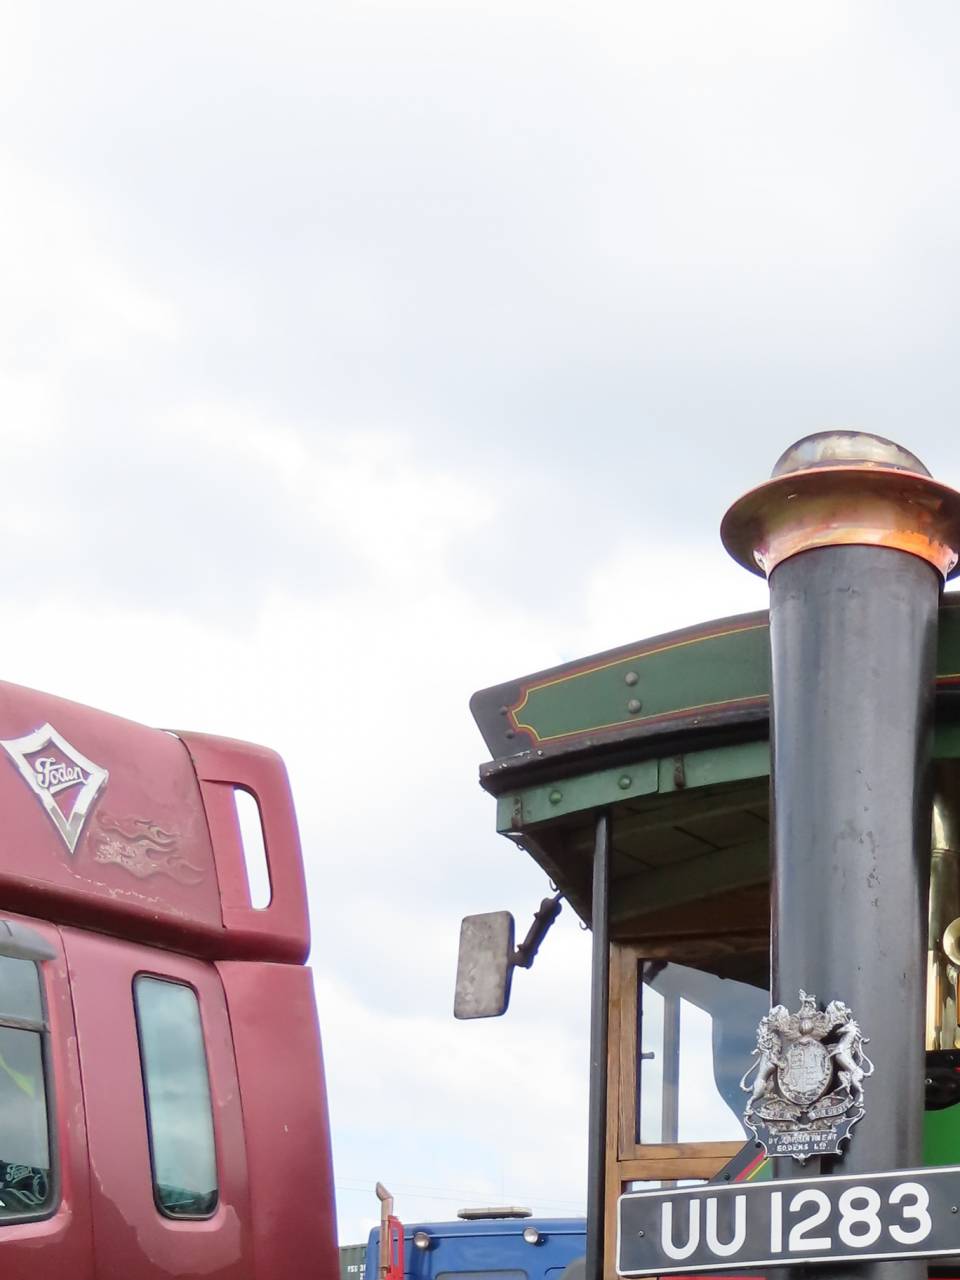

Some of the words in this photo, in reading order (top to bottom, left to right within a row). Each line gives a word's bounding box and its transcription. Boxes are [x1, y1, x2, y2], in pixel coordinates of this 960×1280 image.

[35, 757, 88, 794] Foden
[661, 1194, 747, 1260] UU
[770, 1181, 933, 1254] 1283
